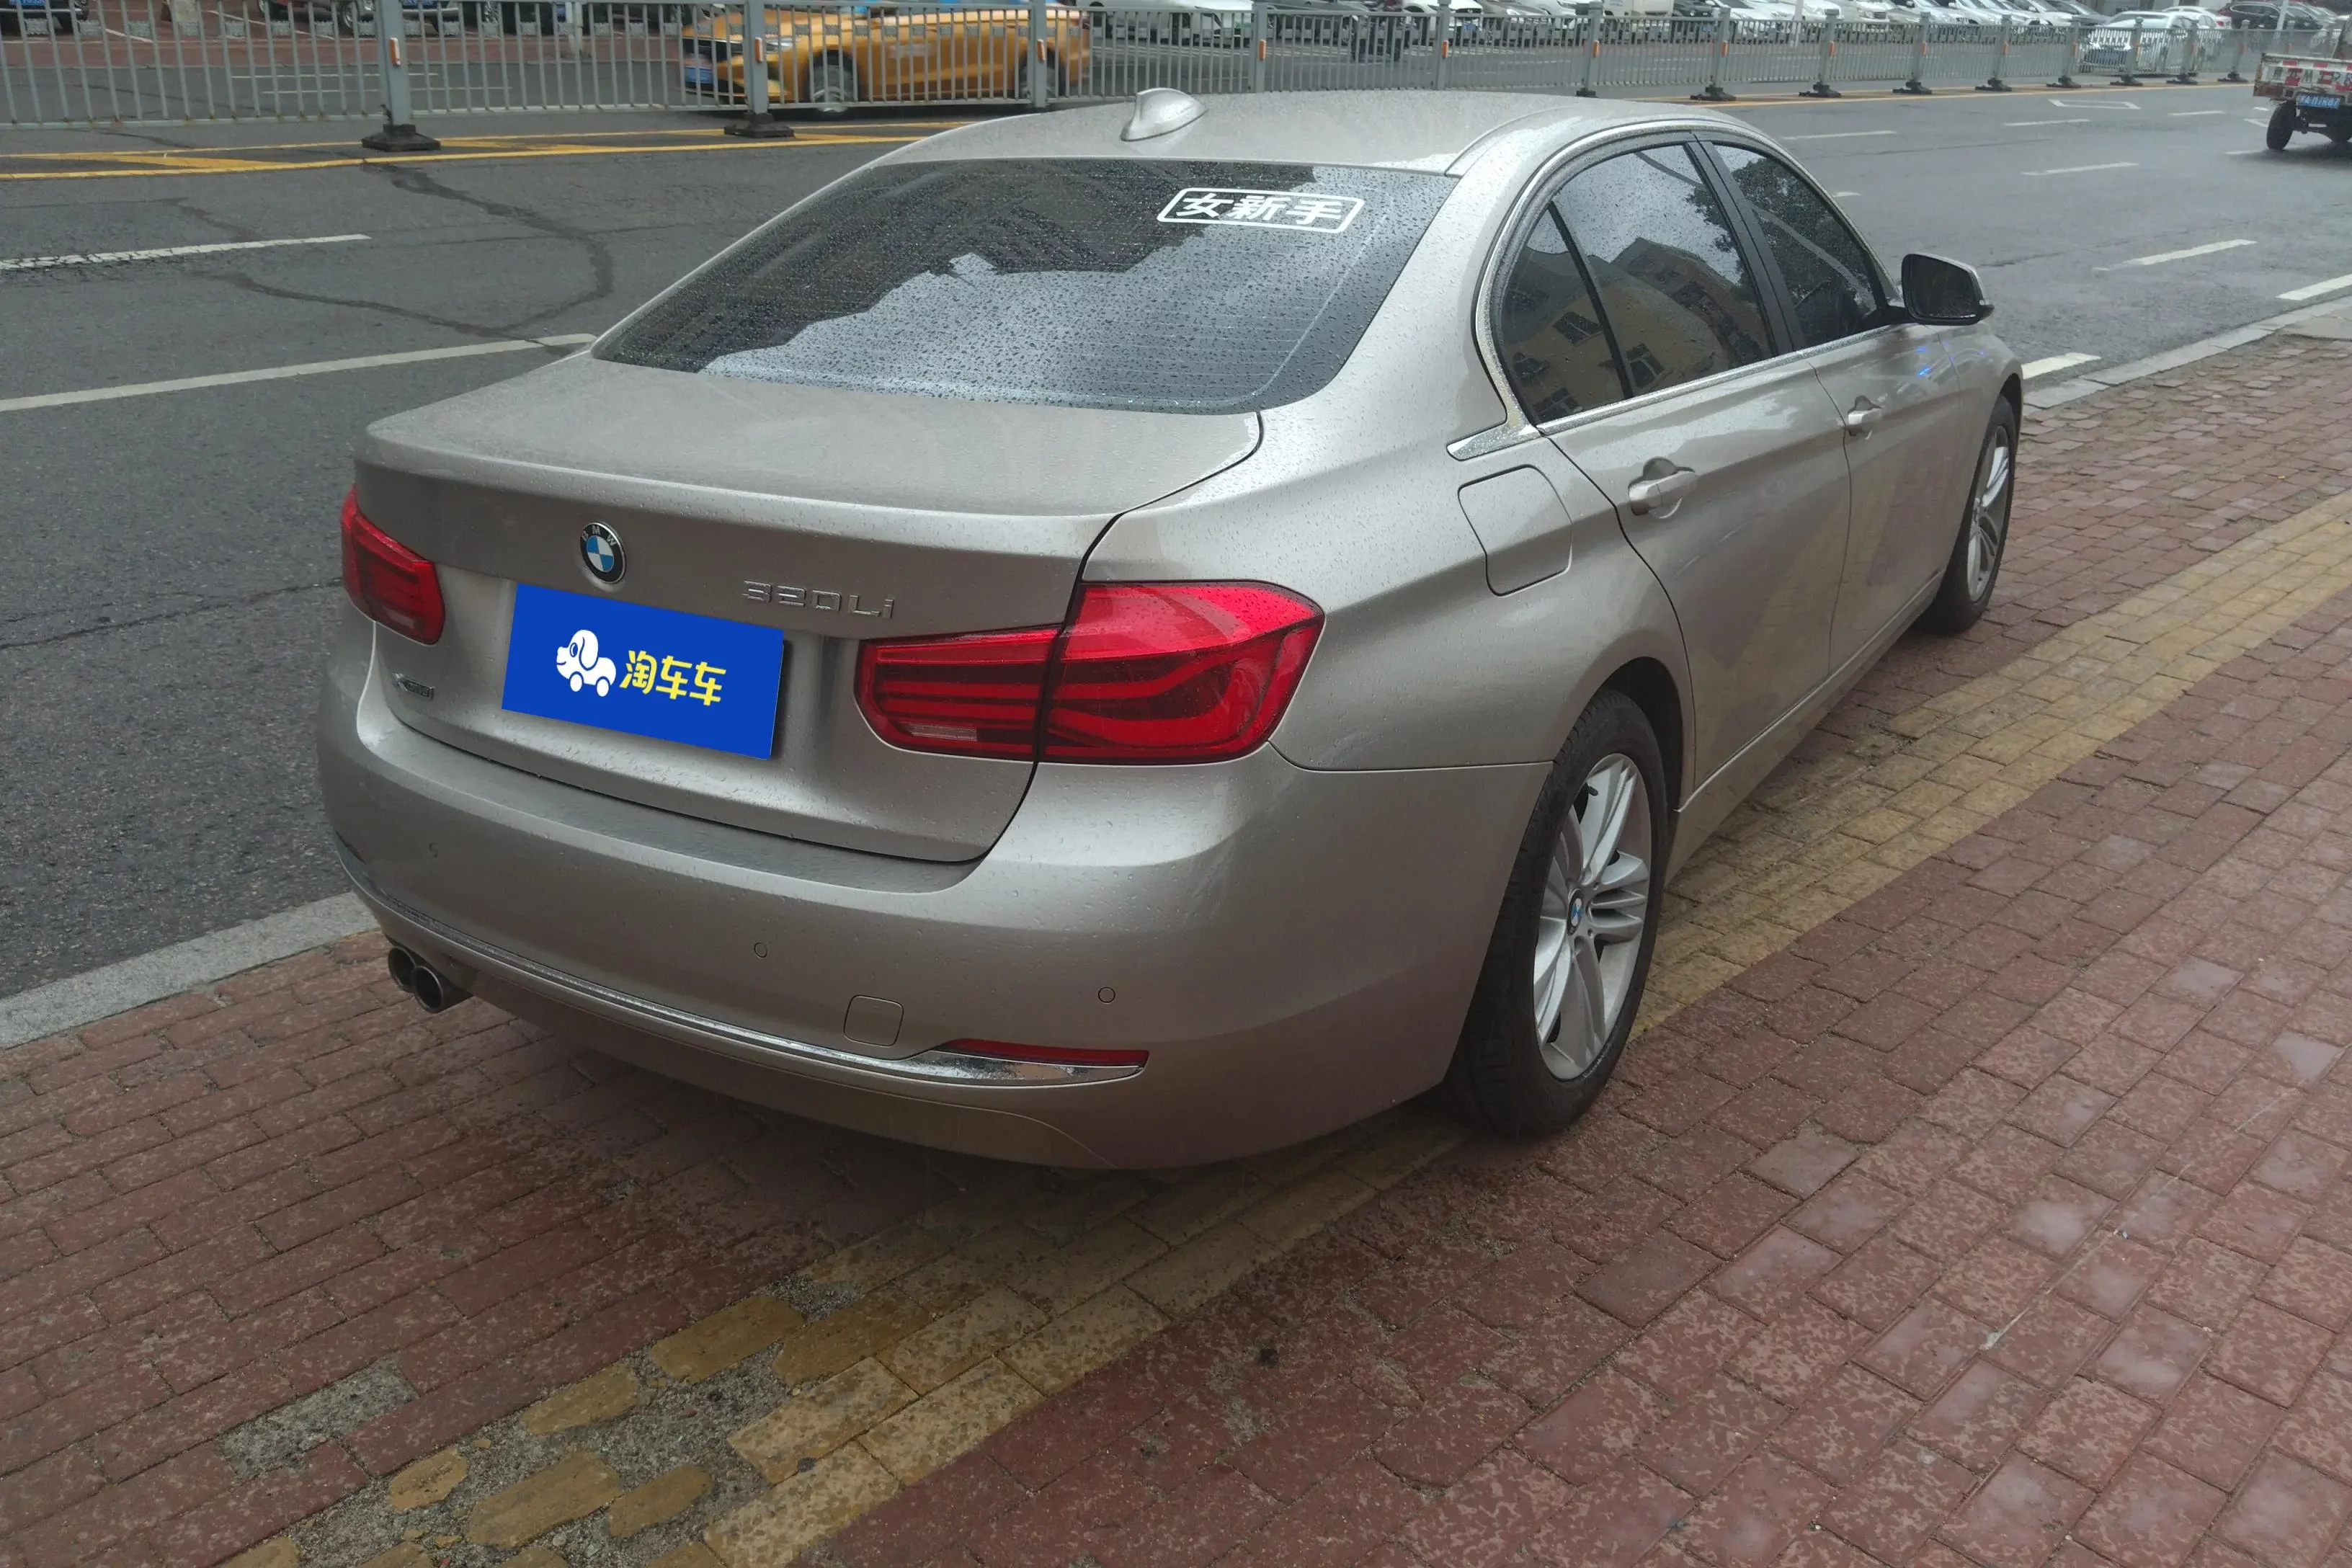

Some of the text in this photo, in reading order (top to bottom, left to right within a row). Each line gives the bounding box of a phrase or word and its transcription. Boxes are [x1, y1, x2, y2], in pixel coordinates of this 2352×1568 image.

[1176, 192, 1342, 225] 女新手
[582, 525, 619, 546] BMW
[741, 580, 894, 619] 320Li
